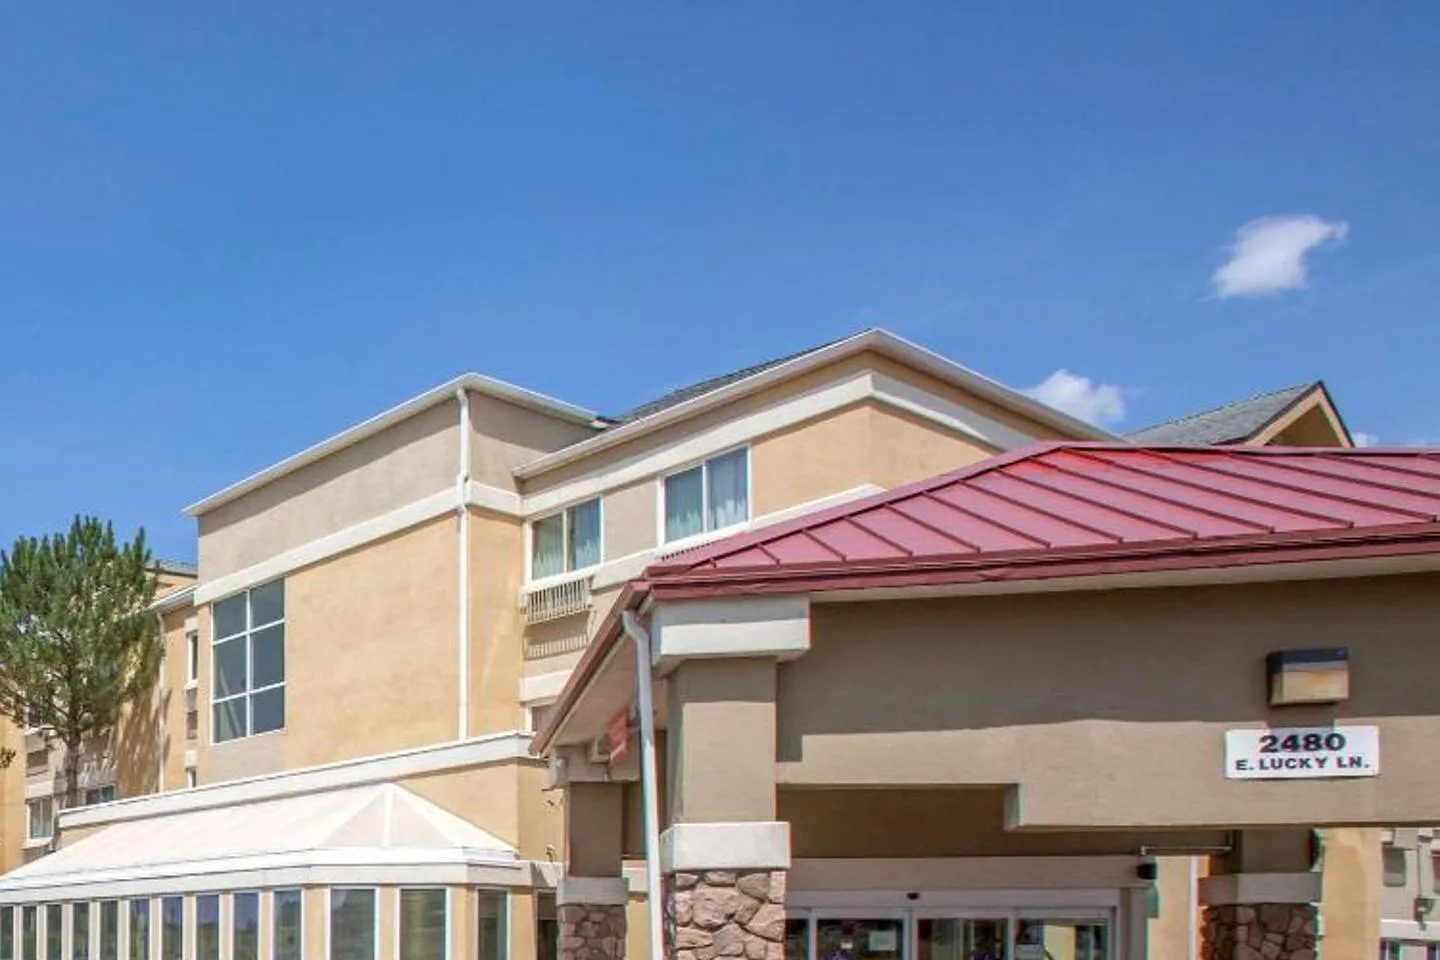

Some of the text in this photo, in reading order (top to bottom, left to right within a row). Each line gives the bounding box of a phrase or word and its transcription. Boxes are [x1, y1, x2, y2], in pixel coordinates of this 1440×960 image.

[1259, 732, 1346, 753] 2480
[1235, 756, 1370, 771] E. LUCKY LN.
